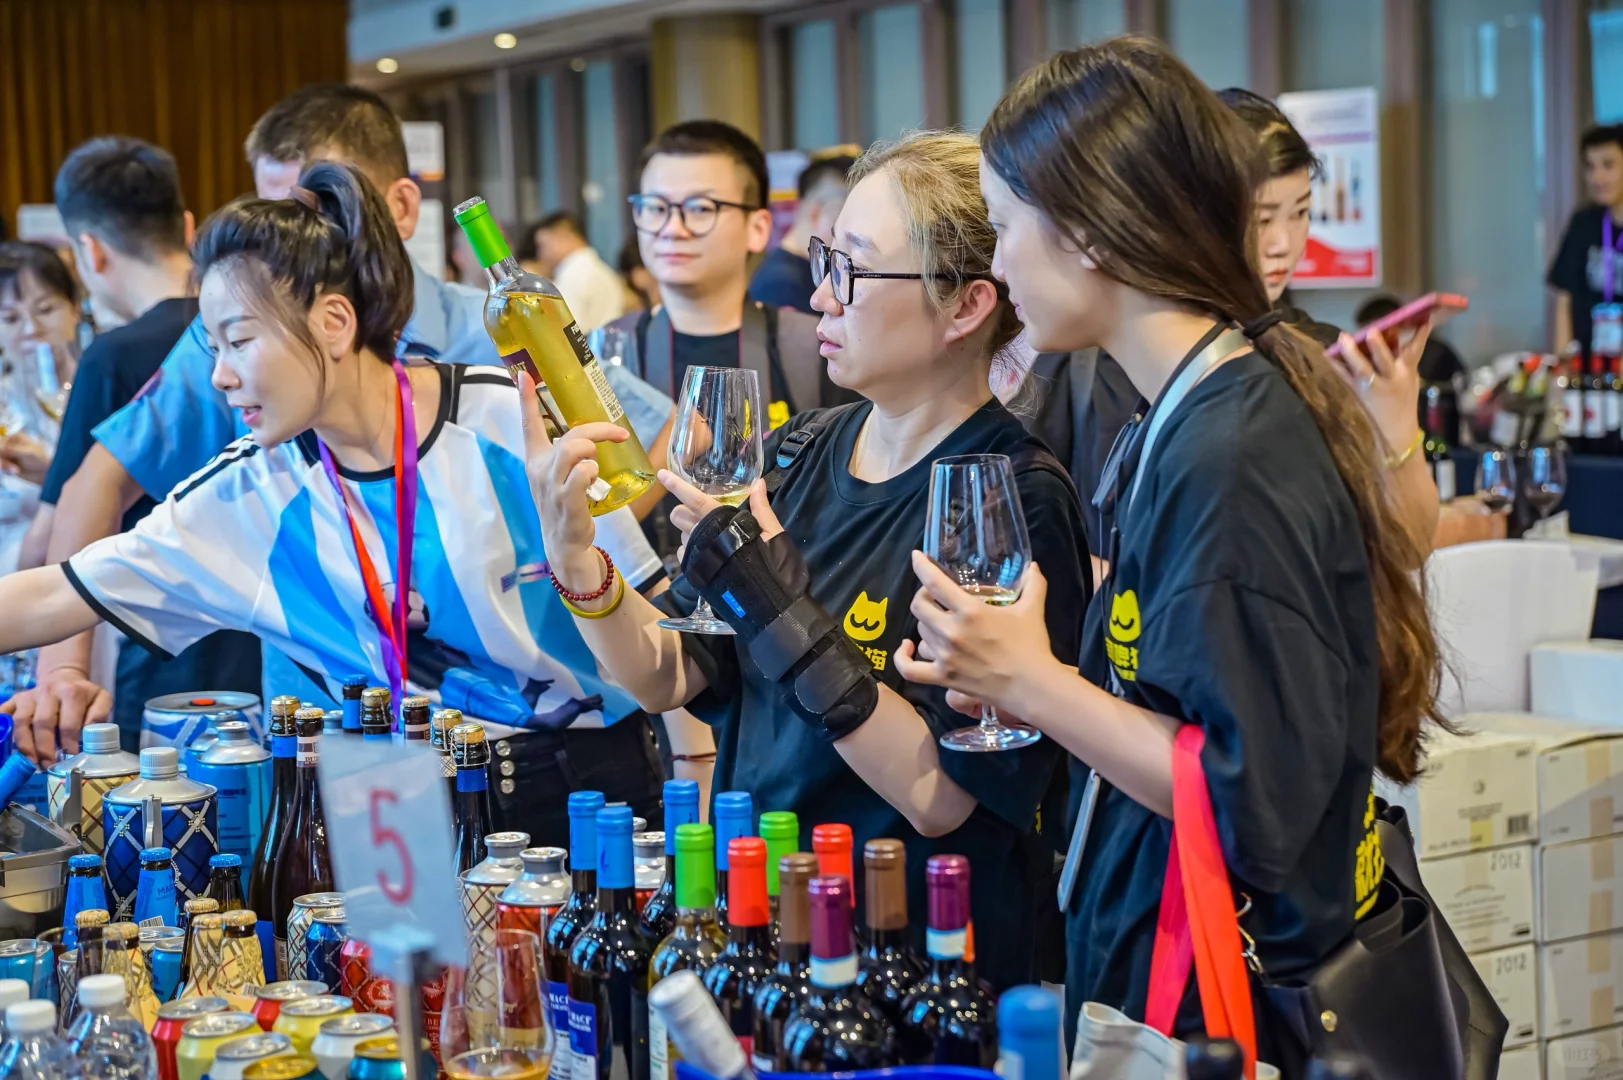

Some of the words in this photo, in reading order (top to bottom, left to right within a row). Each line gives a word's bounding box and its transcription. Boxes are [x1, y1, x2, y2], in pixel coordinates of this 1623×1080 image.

[370, 787, 415, 905] 5
[1490, 852, 1523, 871] 2012
[1496, 953, 1528, 975] 2012
